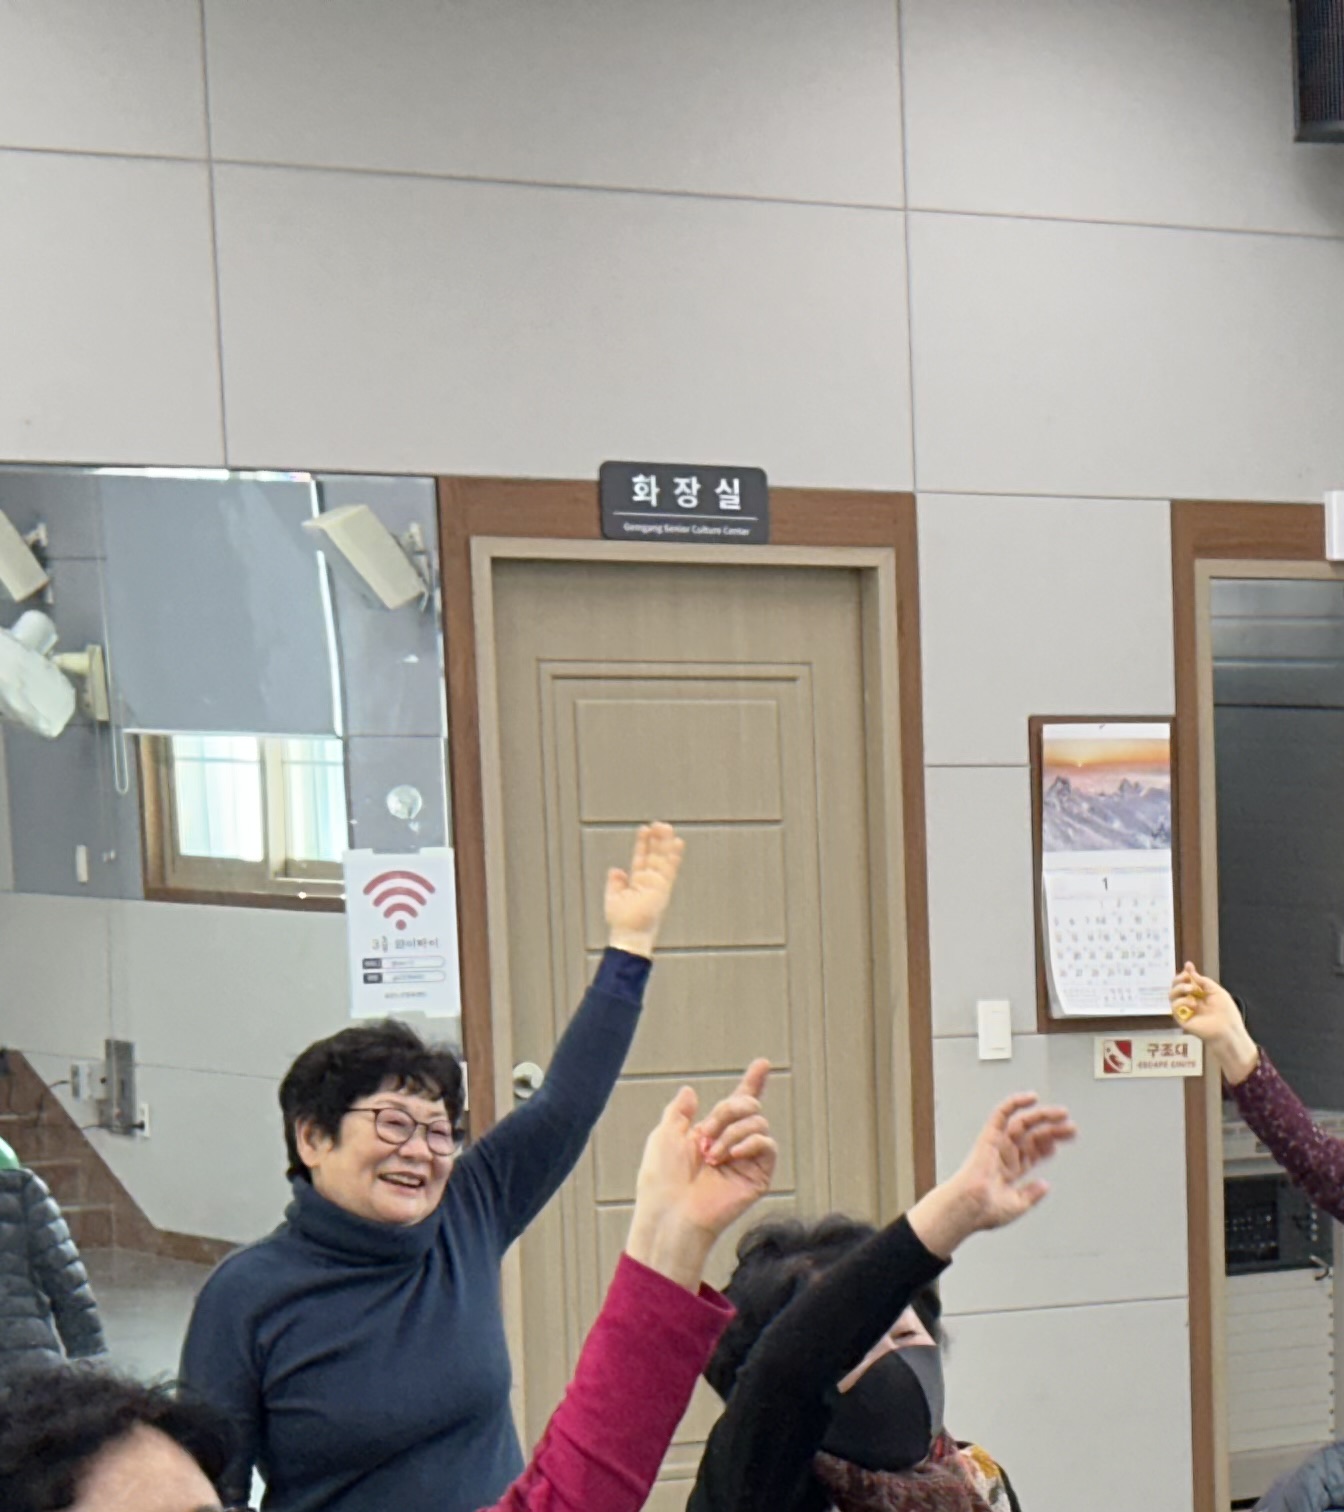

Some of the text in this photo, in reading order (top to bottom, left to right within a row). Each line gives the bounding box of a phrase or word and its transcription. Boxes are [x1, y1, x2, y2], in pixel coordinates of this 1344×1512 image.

[631, 473, 741, 511] 화장실
[722, 526, 750, 537] Center
[1103, 877, 1109, 890] 1
[1146, 1042, 1189, 1058] 구조대
